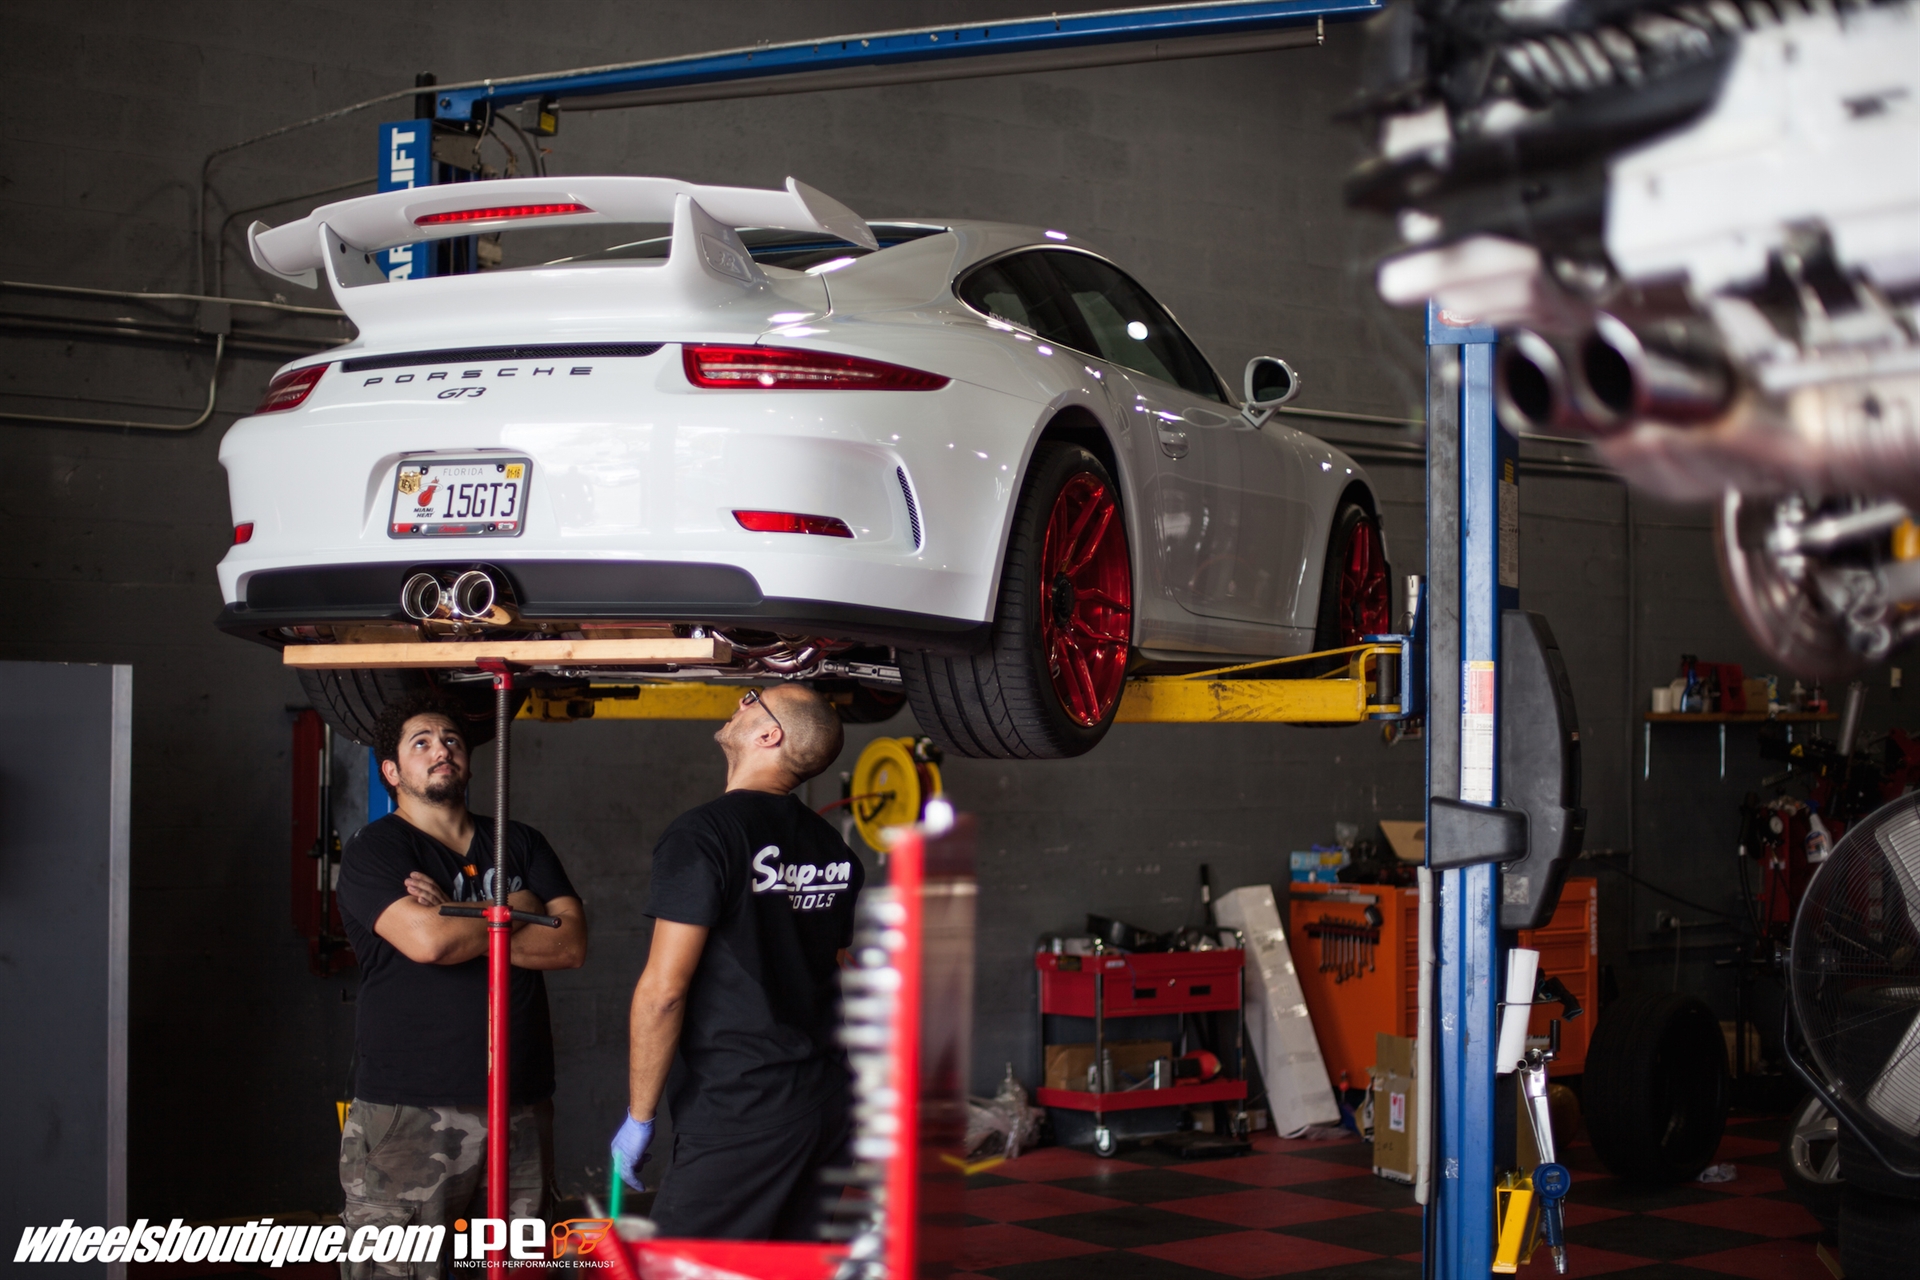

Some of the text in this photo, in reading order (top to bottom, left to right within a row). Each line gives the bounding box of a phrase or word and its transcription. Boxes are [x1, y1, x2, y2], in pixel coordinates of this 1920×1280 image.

[363, 366, 593, 387] PORSCHE
[437, 387, 487, 399] GT3
[443, 467, 484, 477] FLORIDA
[442, 483, 517, 518] 15GT3
